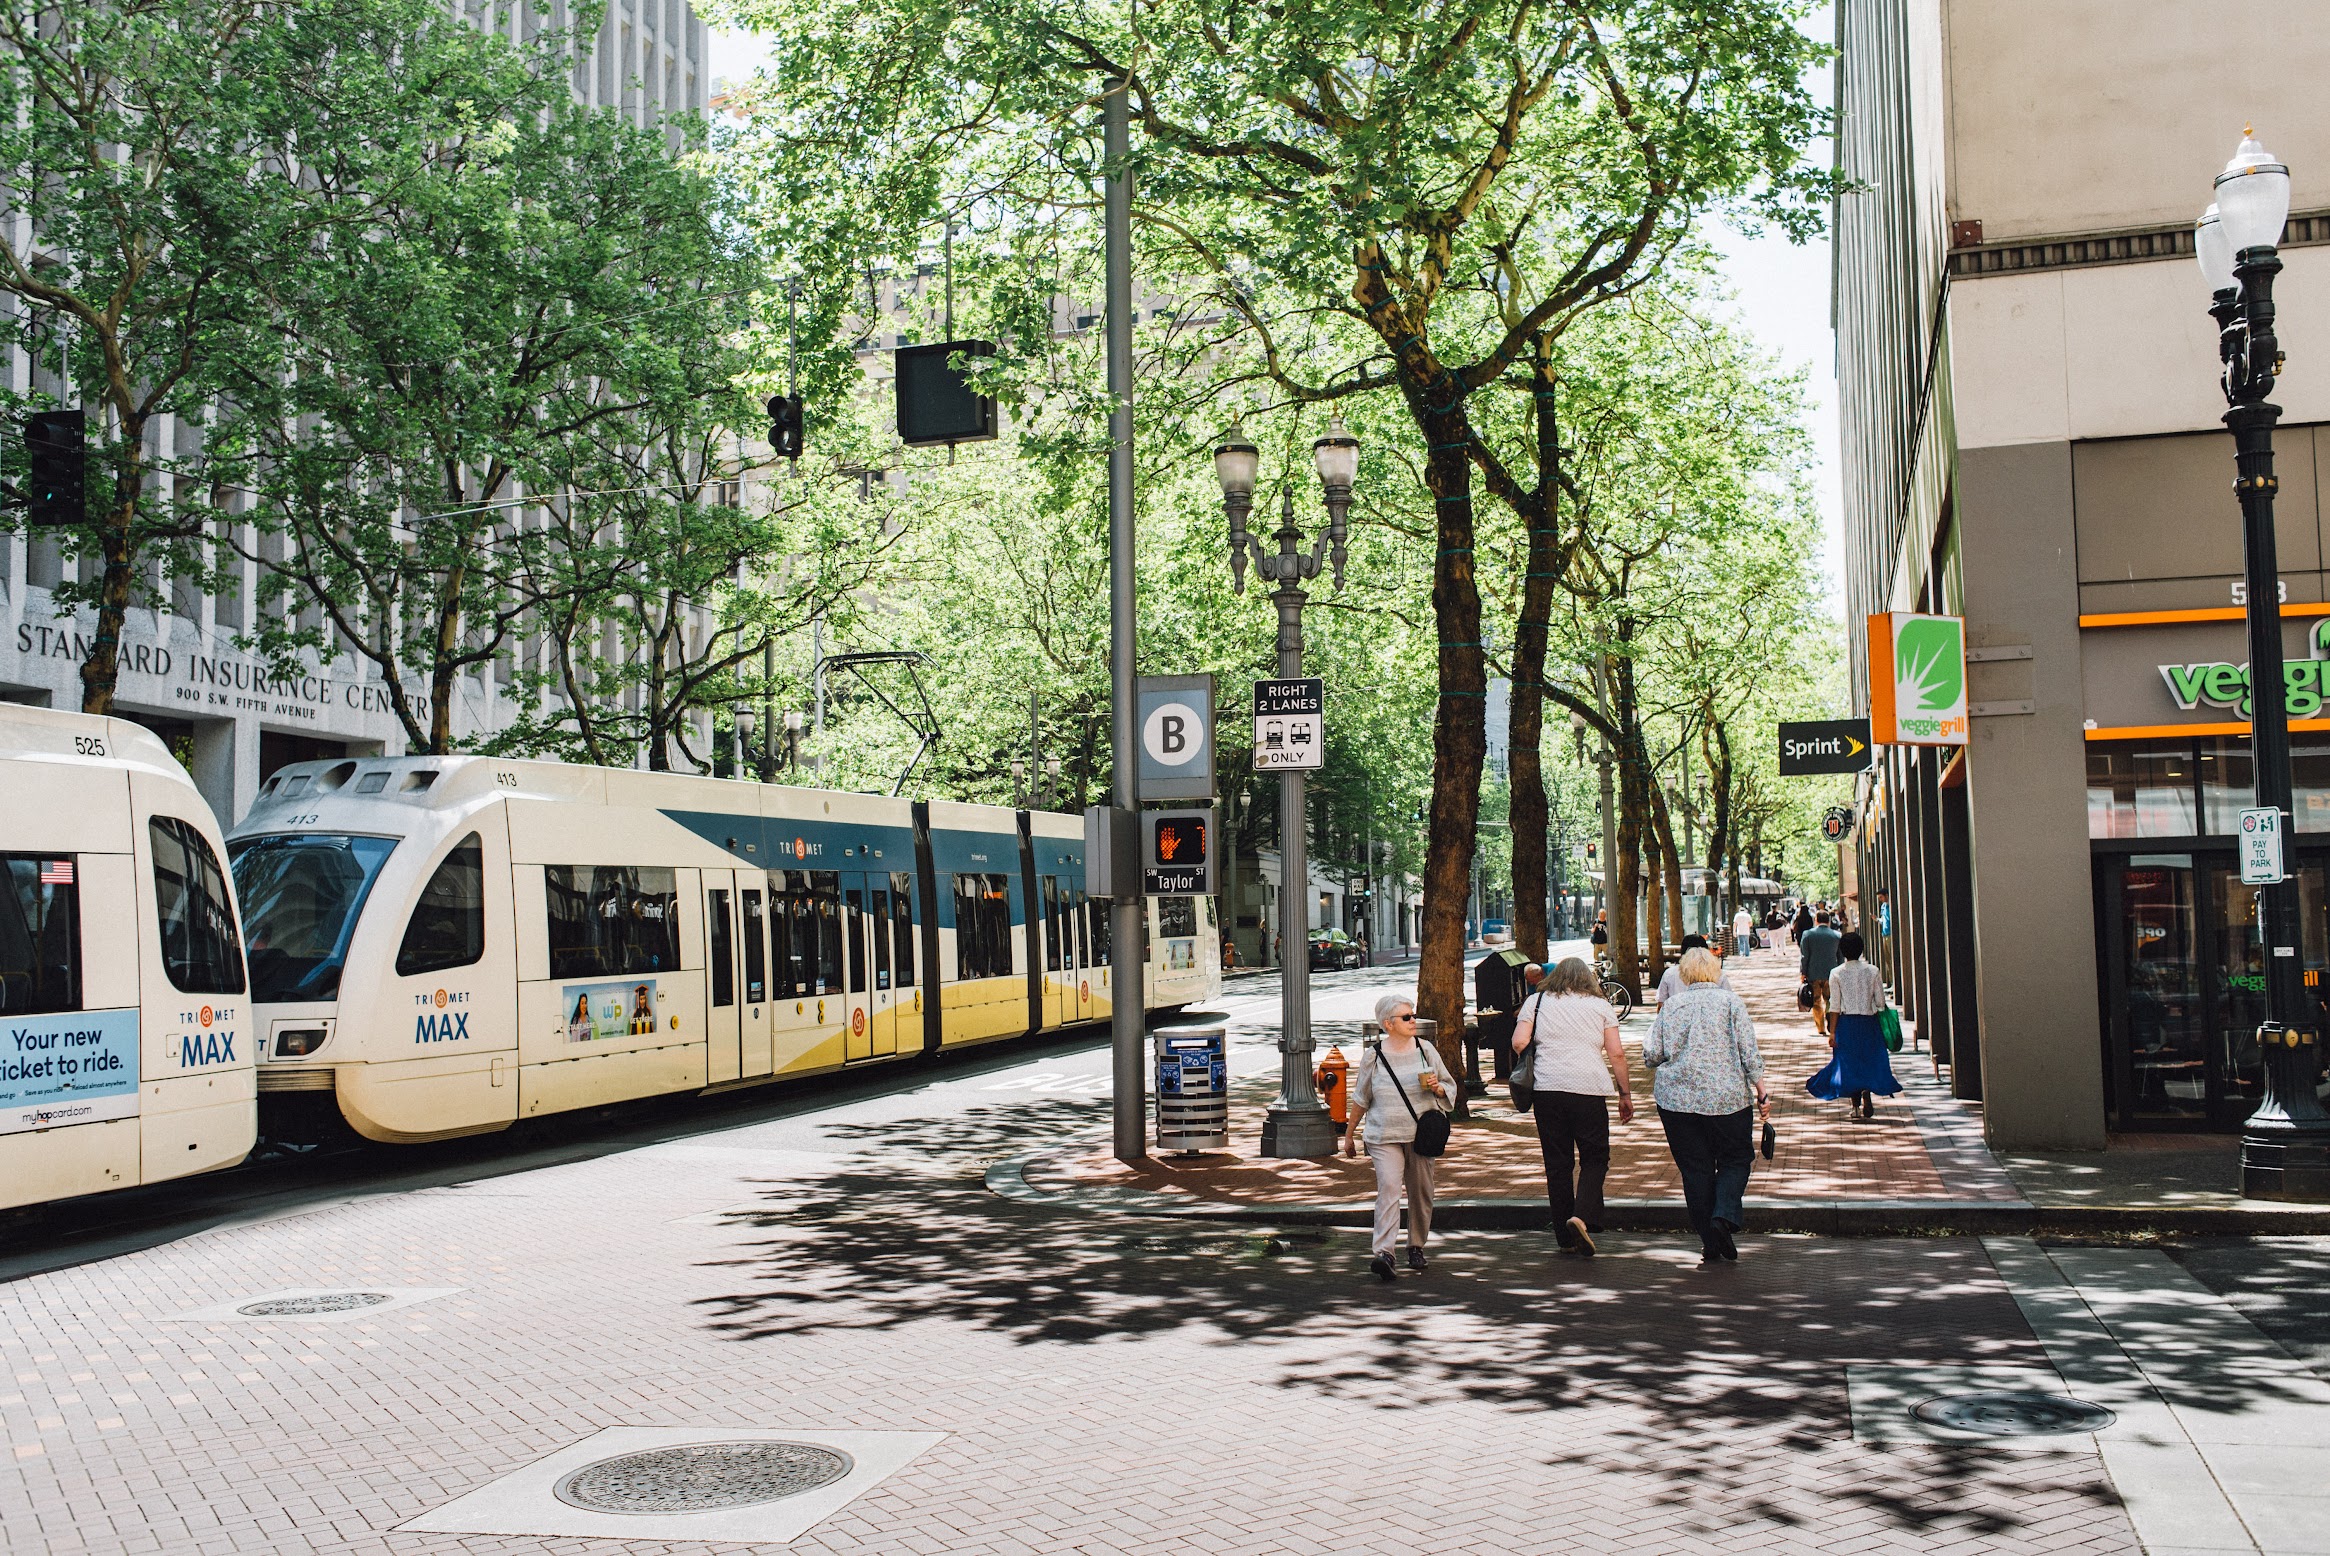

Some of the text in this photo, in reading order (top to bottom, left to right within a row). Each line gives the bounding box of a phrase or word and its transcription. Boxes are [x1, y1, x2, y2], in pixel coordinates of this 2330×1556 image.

[17, 623, 428, 721] STANARD INSURANCE CENER
[1268, 685, 1308, 697] RIGHT
[177, 687, 316, 719] 900 S.W. FIFTH AVENUE
[1259, 698, 1318, 711] 2 LANES
[1162, 715, 1186, 754] B
[75, 736, 105, 757] 525
[1784, 737, 1841, 760] Sprint
[1271, 752, 1305, 763] ONLY
[496, 772, 518, 787] 413
[286, 814, 319, 825] 413
[2252, 841, 2267, 849] PAY
[2255, 849, 2266, 858] TO
[2250, 859, 2272, 868] PARK
[1146, 867, 1204, 892] SW Taylor ST
[415, 1012, 470, 1044] MAX
[11, 1028, 103, 1052] Your new
[181, 1031, 236, 1068] MAX
[0, 1048, 124, 1082] icket to ride.
[24, 1089, 37, 1097] Save
[22, 1105, 92, 1125] myhopcard.com
